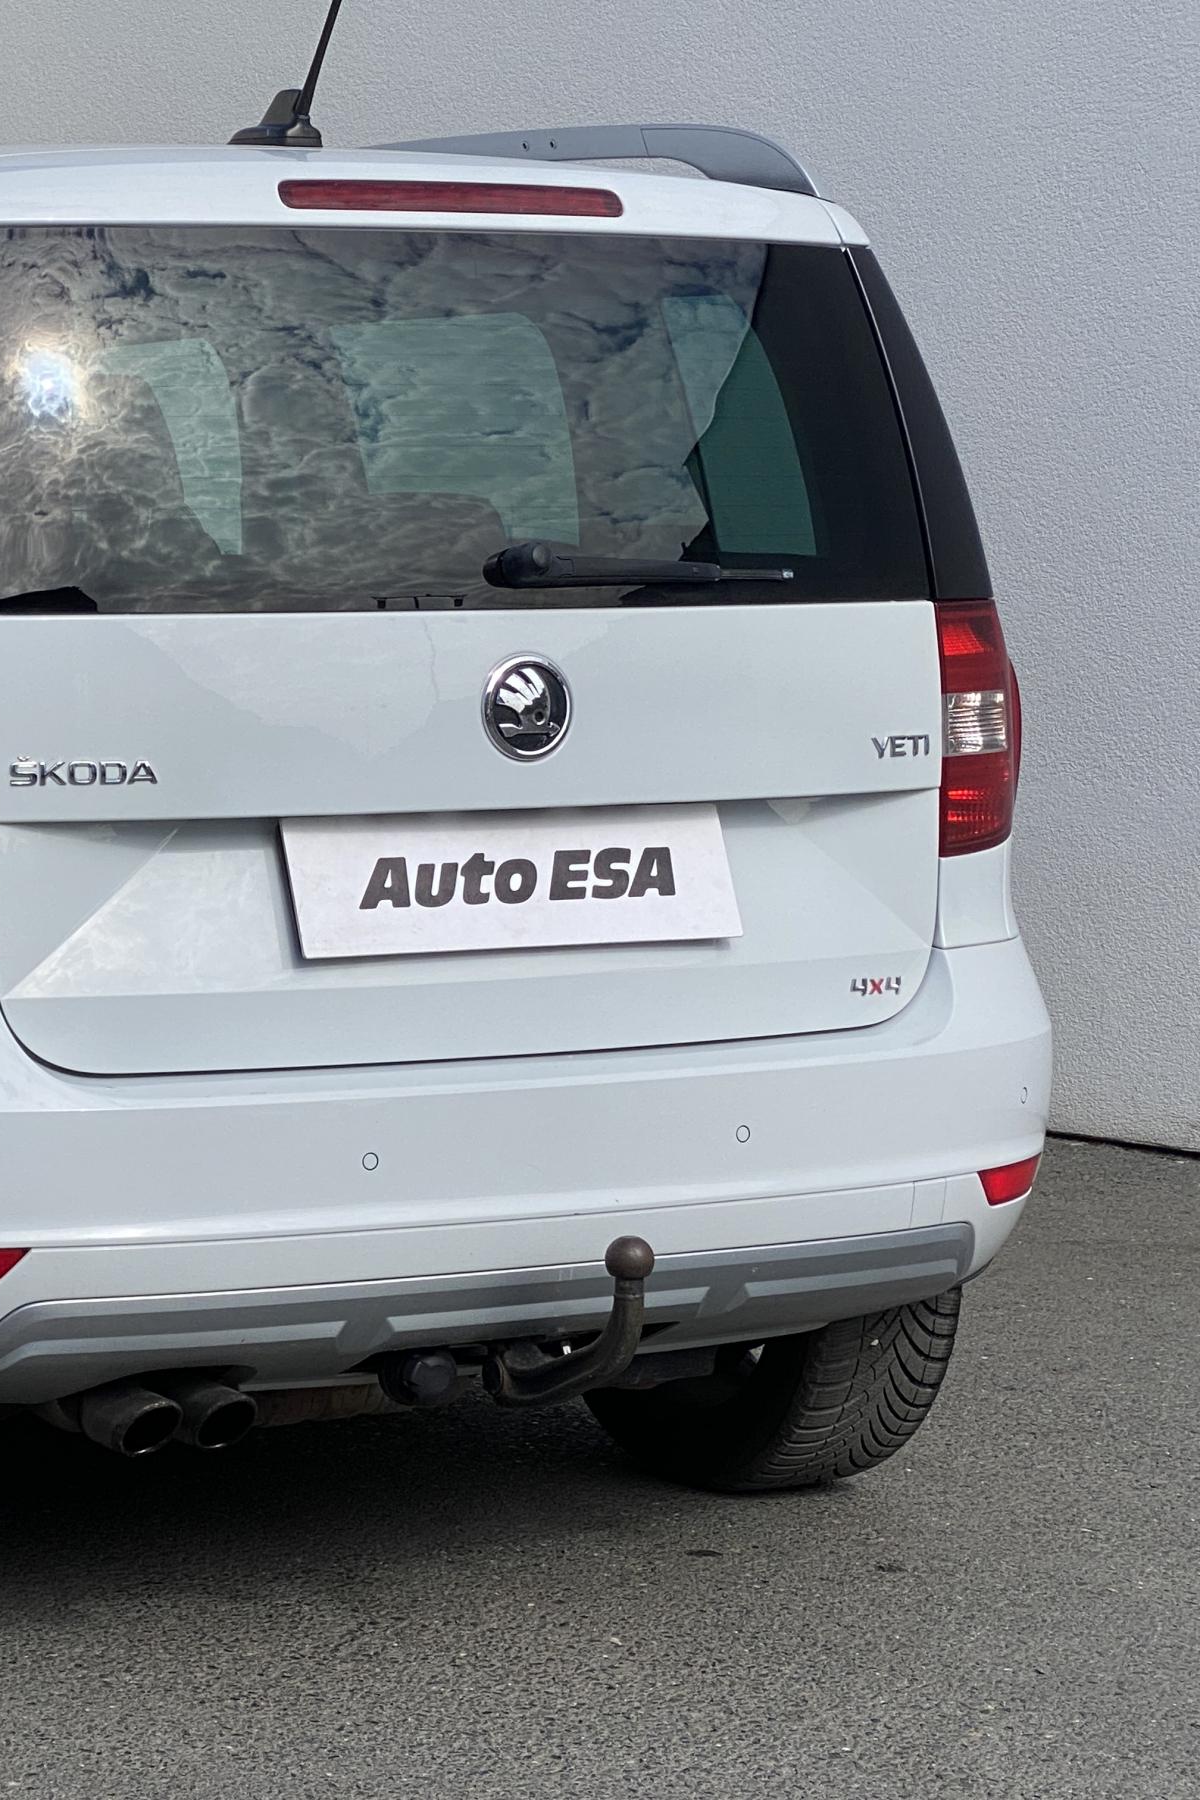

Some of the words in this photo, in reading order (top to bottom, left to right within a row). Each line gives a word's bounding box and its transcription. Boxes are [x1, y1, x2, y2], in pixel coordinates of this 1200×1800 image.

[870, 734, 930, 759] YETI
[9, 755, 158, 787] ŠKODA
[359, 852, 538, 910] Auto
[549, 846, 676, 901] ESA
